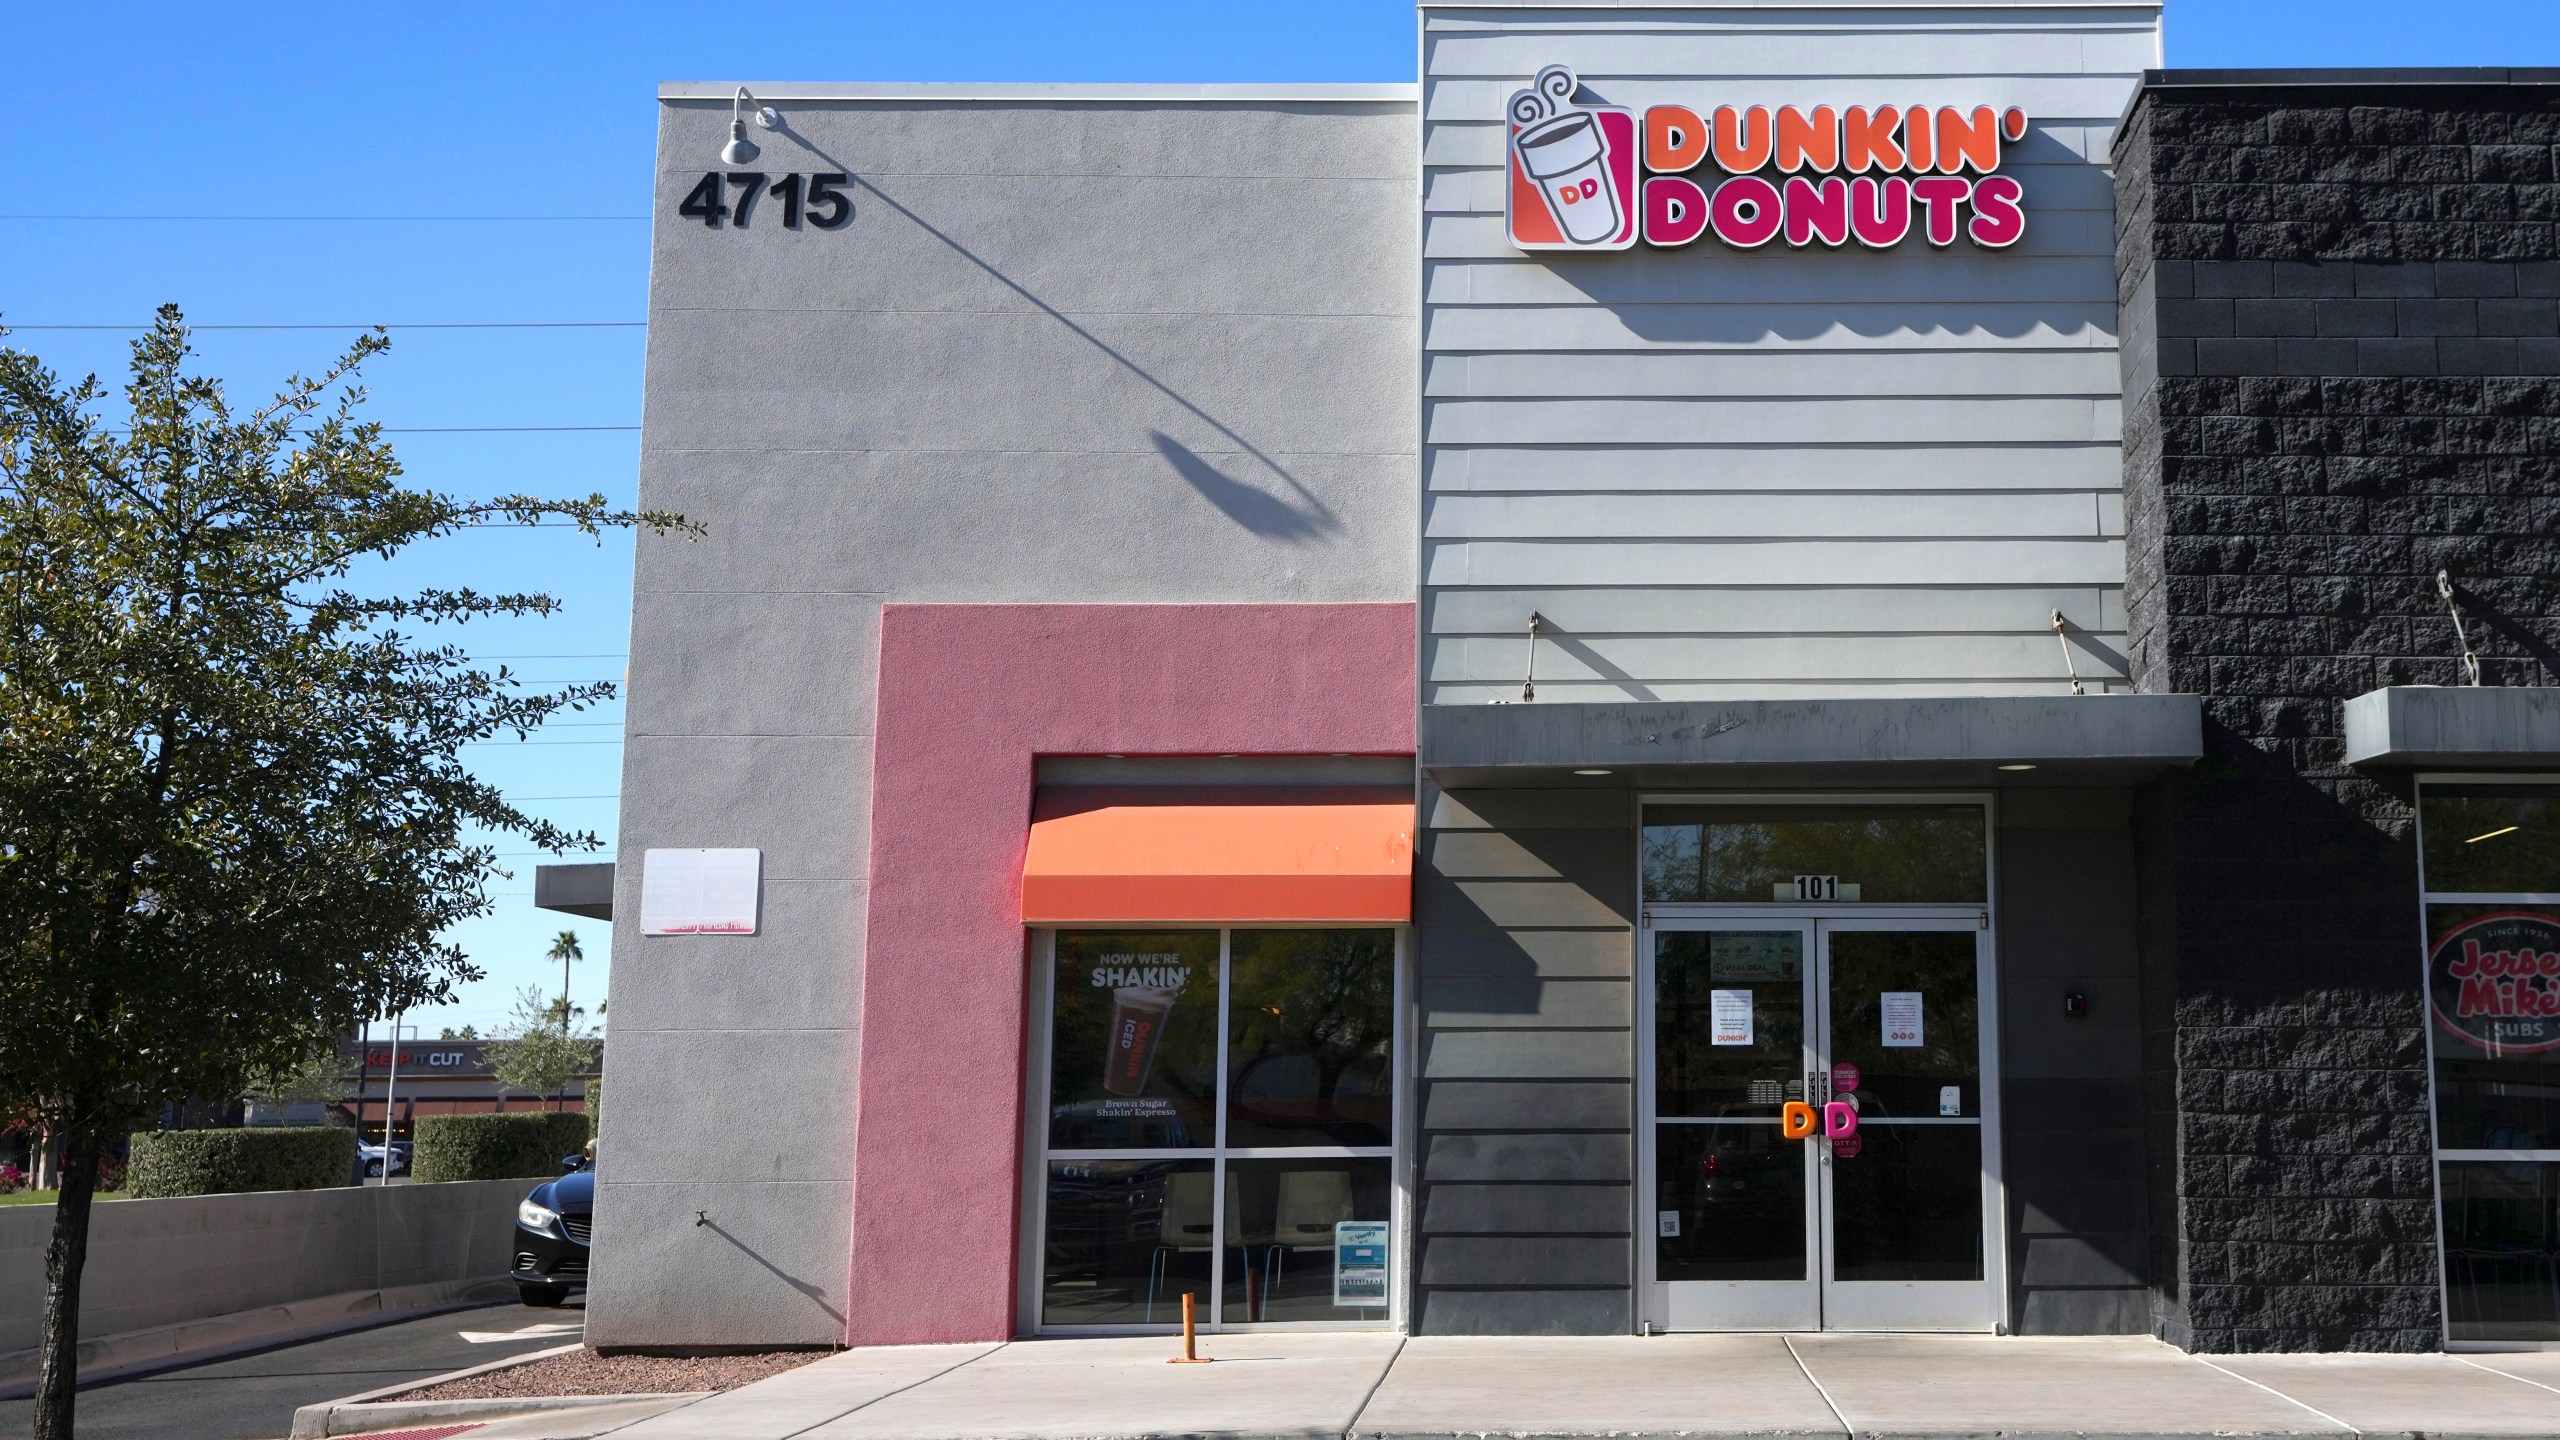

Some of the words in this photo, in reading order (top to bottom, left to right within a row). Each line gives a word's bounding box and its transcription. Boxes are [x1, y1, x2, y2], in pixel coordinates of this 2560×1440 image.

[1643, 104, 2027, 174] DUNKIN'
[679, 172, 849, 228] 4715
[1559, 178, 1598, 205] DD
[1643, 175, 2025, 248] DONUTS
[1798, 877, 1835, 899] 101
[2487, 928, 2520, 938] SINCE
[2525, 928, 2550, 939] 1956
[1100, 953, 1134, 964] NOW
[1138, 953, 1179, 964] WE'RE
[2448, 939, 2560, 979] Jerse
[1092, 967, 1191, 987] SHAKIN'
[2457, 977, 2560, 1019] Mike'
[1122, 1019, 1136, 1049] ICED
[2495, 1022, 2544, 1037] SUBS
[430, 1052, 463, 1066] CUT
[1097, 1108, 1133, 1117] Shakin'
[1135, 1108, 1176, 1117] Espresso
[1105, 1100, 1137, 1108] Brown
[1140, 1100, 1168, 1109] Sugar
